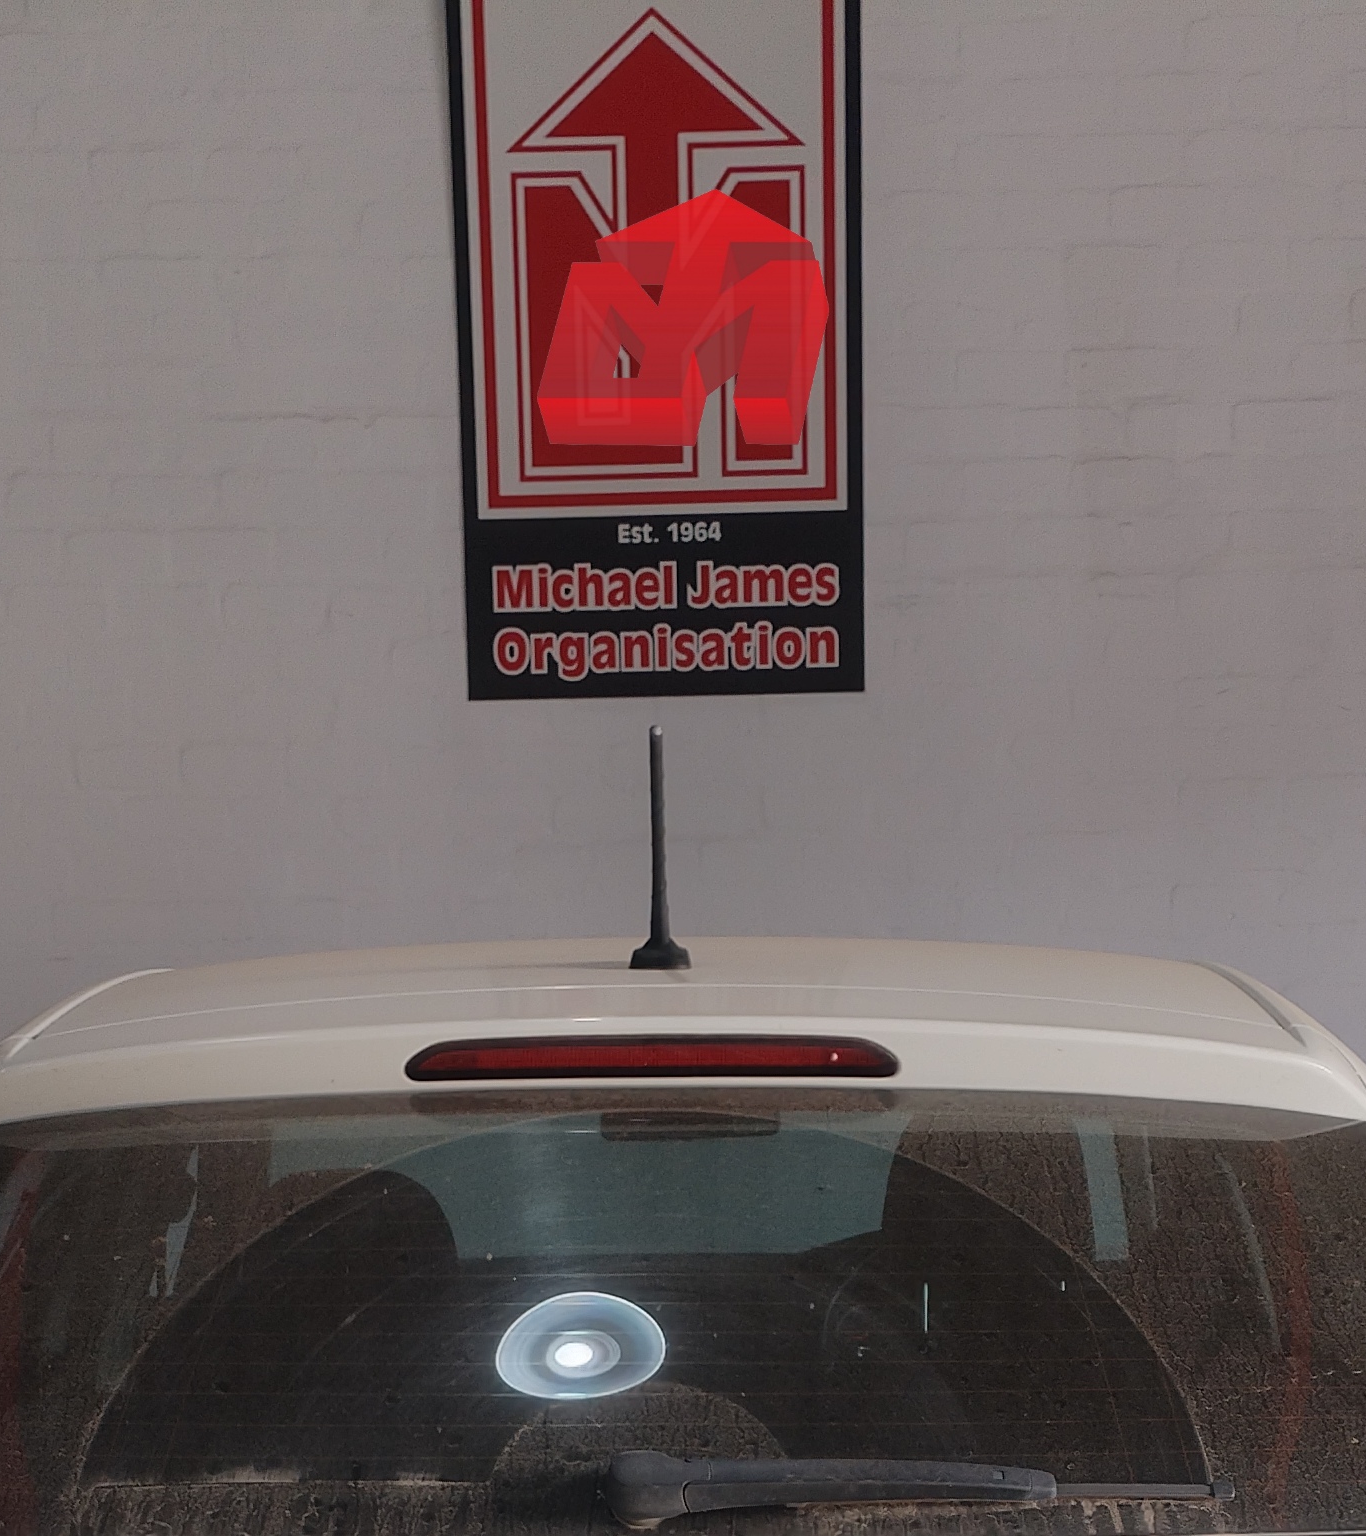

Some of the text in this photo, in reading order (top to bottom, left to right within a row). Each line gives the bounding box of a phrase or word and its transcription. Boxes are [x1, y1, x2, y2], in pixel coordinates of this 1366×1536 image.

[617, 521, 722, 544] Est. 1964
[492, 560, 840, 613] Michael James
[493, 621, 840, 681] Organisation
